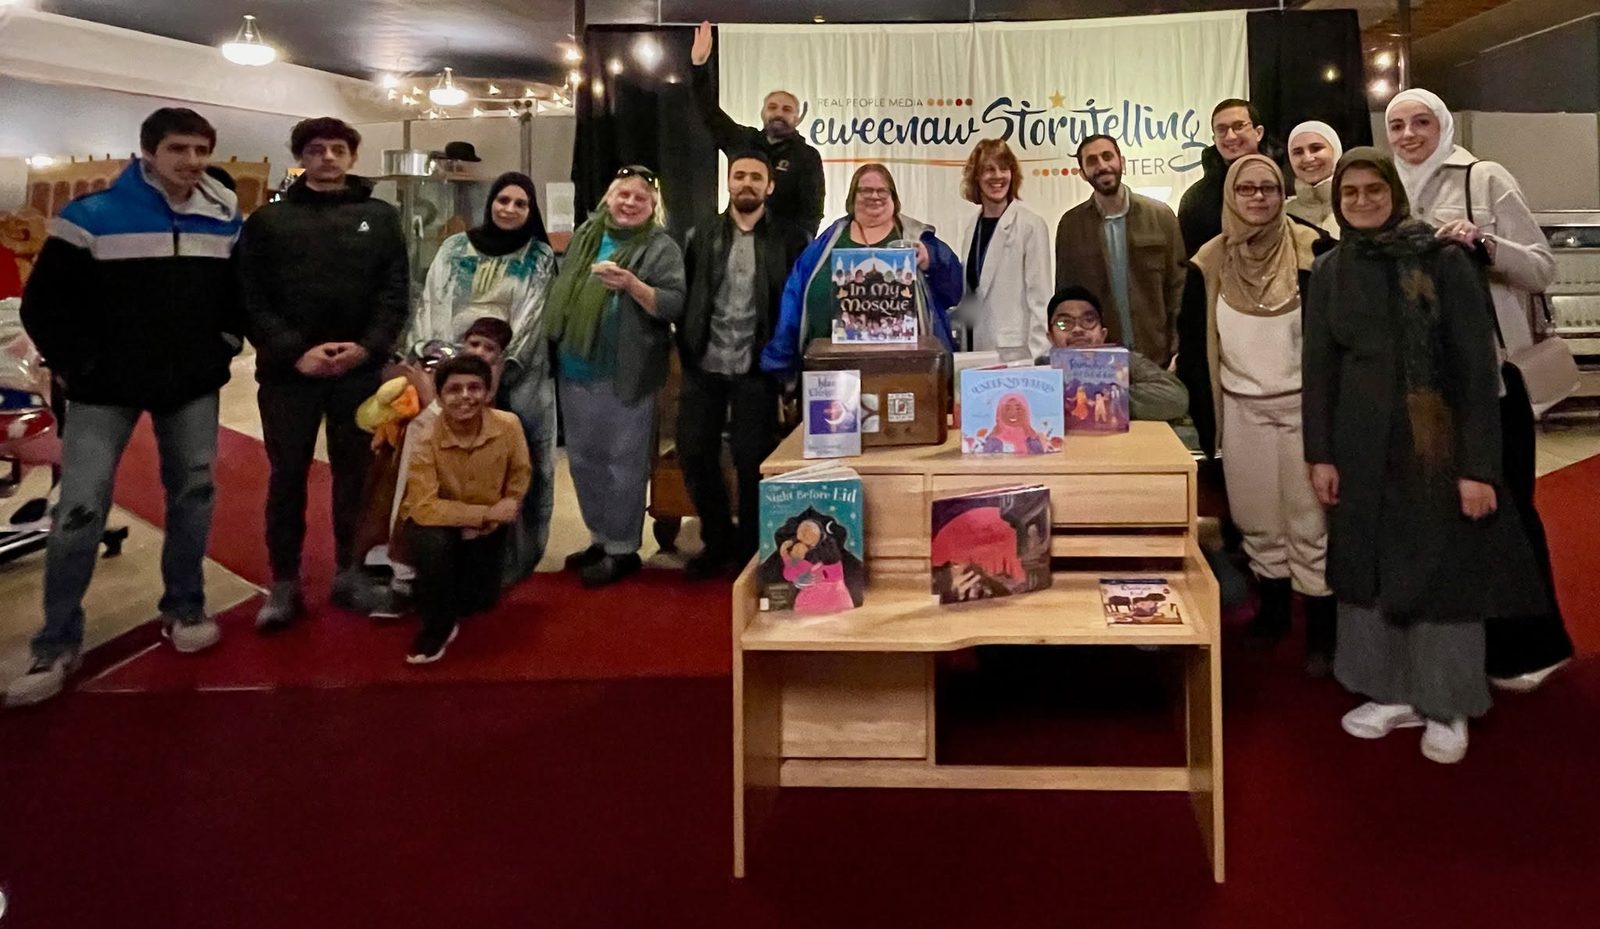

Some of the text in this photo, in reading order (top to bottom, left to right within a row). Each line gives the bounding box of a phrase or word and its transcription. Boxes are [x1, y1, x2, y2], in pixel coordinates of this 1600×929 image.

[846, 98, 885, 107] PEOPLE
[888, 98, 924, 107] MEDIA
[851, 283, 900, 297] In My
[841, 299, 910, 315] Mosque
[833, 487, 857, 503] Eid
